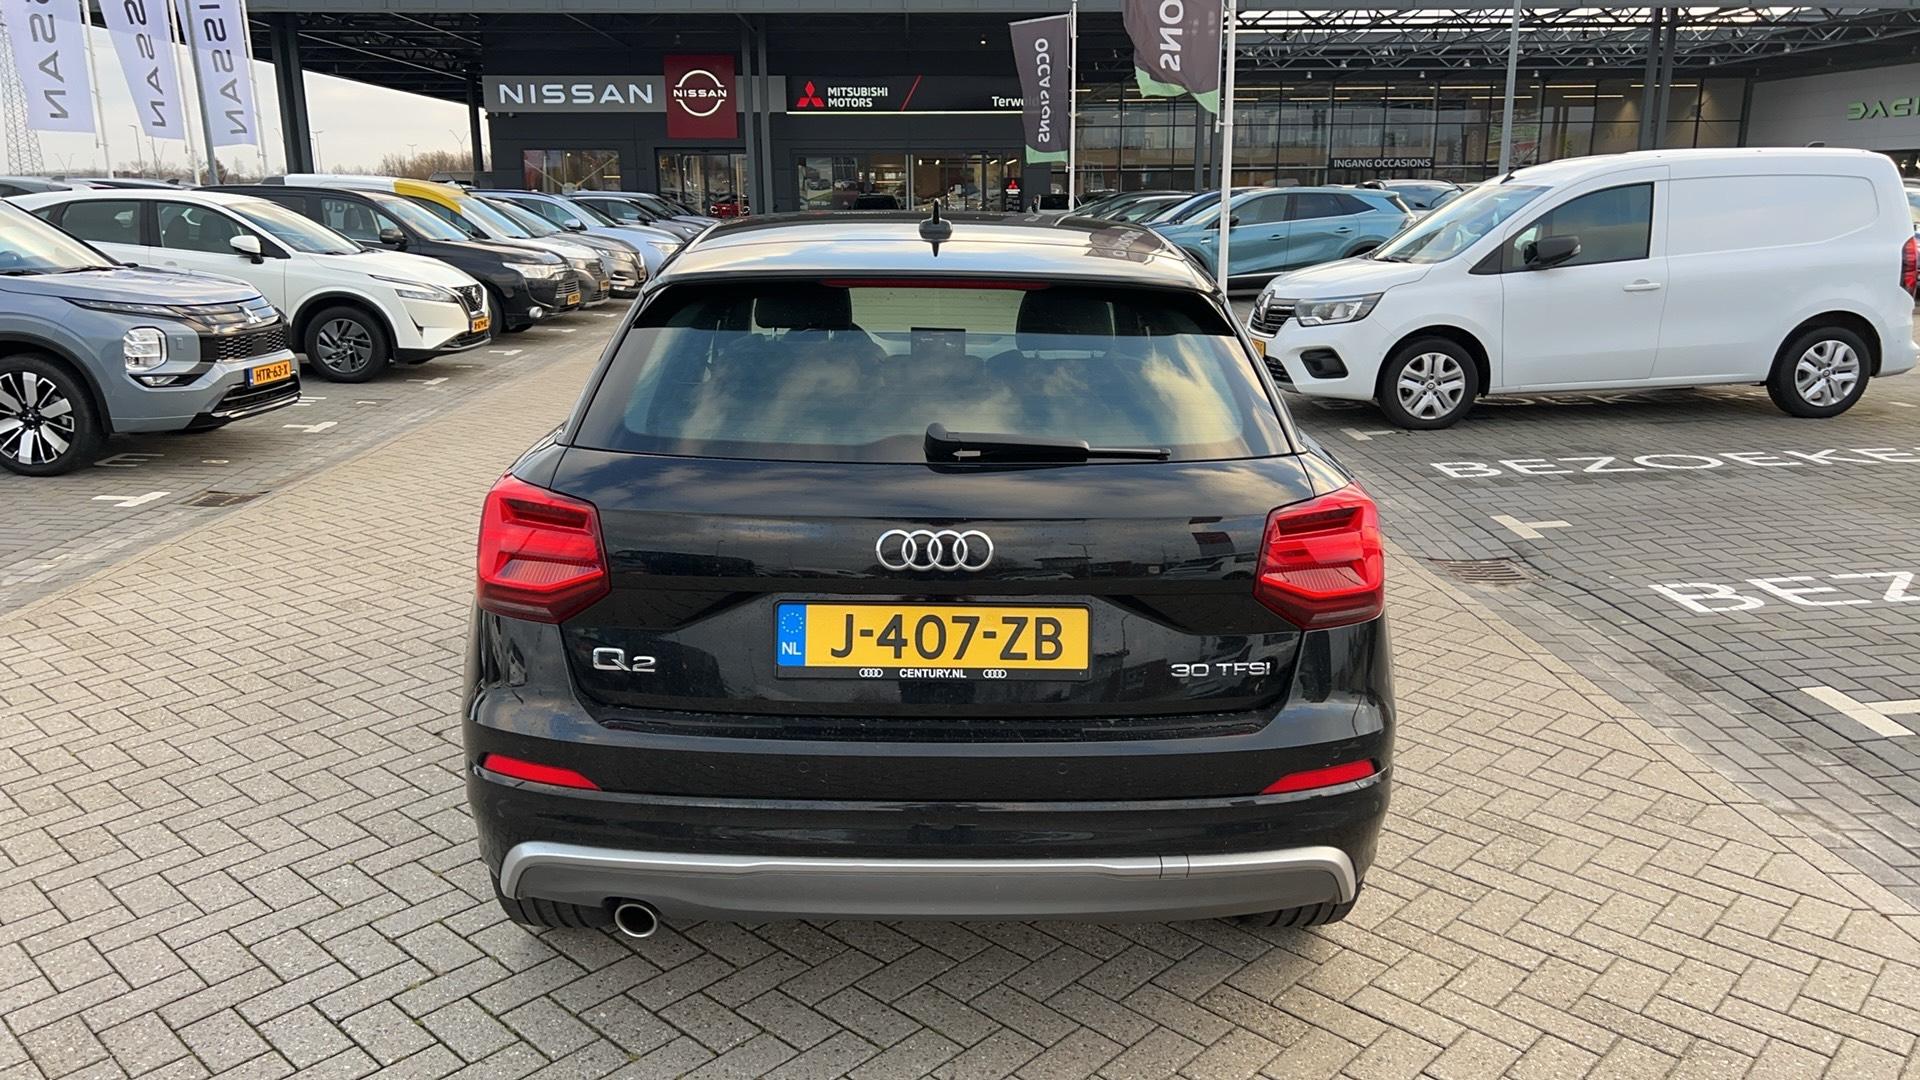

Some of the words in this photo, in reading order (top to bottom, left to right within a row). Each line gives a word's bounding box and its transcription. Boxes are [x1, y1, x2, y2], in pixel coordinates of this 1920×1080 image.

[499, 83, 653, 104] NISSAN
[673, 88, 727, 98] NISSAN
[827, 86, 888, 97] MITSUBISHI
[827, 98, 873, 108] MOTORS
[1334, 159, 1372, 168] INGANG
[1374, 158, 1431, 168] OCCASIONS
[255, 364, 289, 382] HTR-63-X
[1430, 447, 1920, 478] BEZOEKE
[830, 613, 1063, 661] J-407-ZB
[782, 641, 802, 656] NL
[592, 647, 656, 672] Q2
[899, 668, 967, 679] CENTURY.NL
[1171, 663, 1210, 678] 30
[1216, 661, 1271, 676] TFSI
